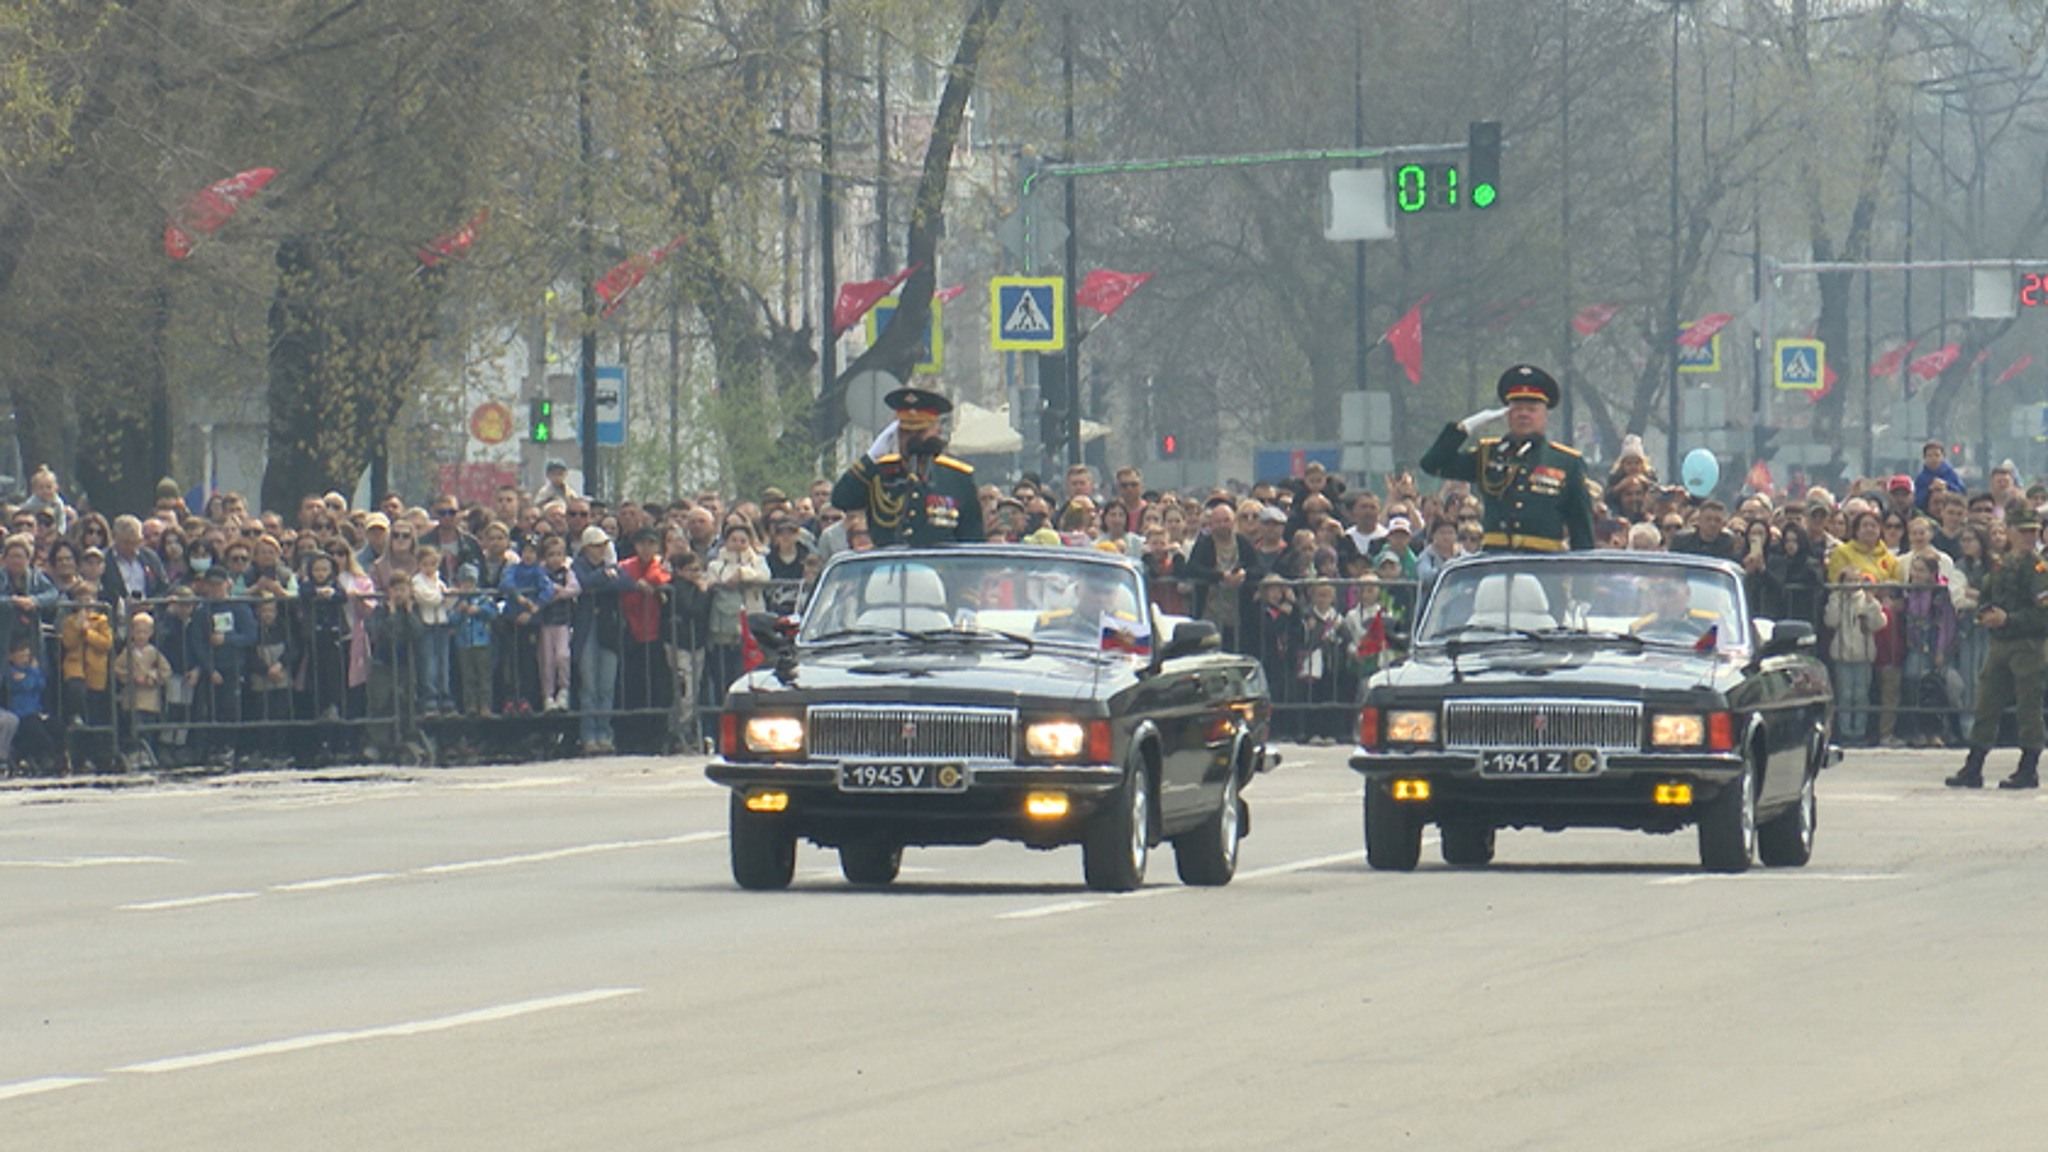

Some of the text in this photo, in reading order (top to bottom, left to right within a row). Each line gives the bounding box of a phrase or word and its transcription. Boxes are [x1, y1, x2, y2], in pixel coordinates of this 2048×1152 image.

[1399, 165, 1457, 211] 01
[2021, 273, 2048, 306] 2
[1493, 753, 1562, 772] 1941 Z
[853, 766, 925, 786] 1945 V
